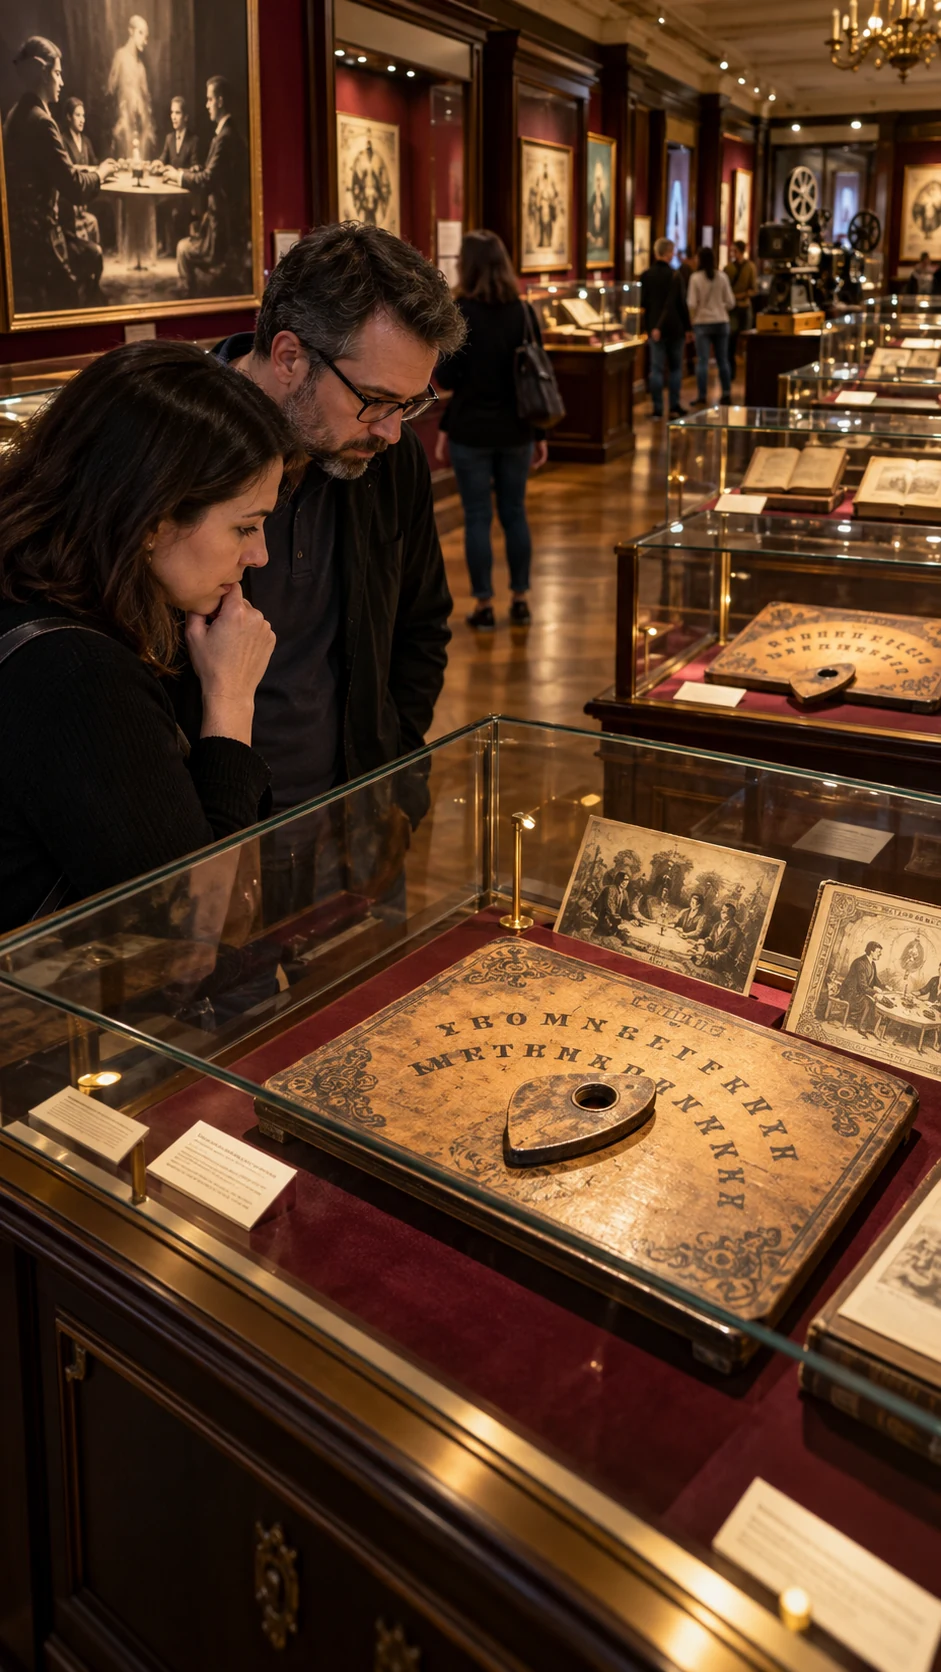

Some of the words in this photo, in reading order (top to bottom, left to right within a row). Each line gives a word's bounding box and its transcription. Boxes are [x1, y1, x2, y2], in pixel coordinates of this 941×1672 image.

[505, 1012, 528, 1026] O
[540, 1012, 572, 1027] M
[581, 1016, 608, 1033] N
[492, 1043, 514, 1058] T
